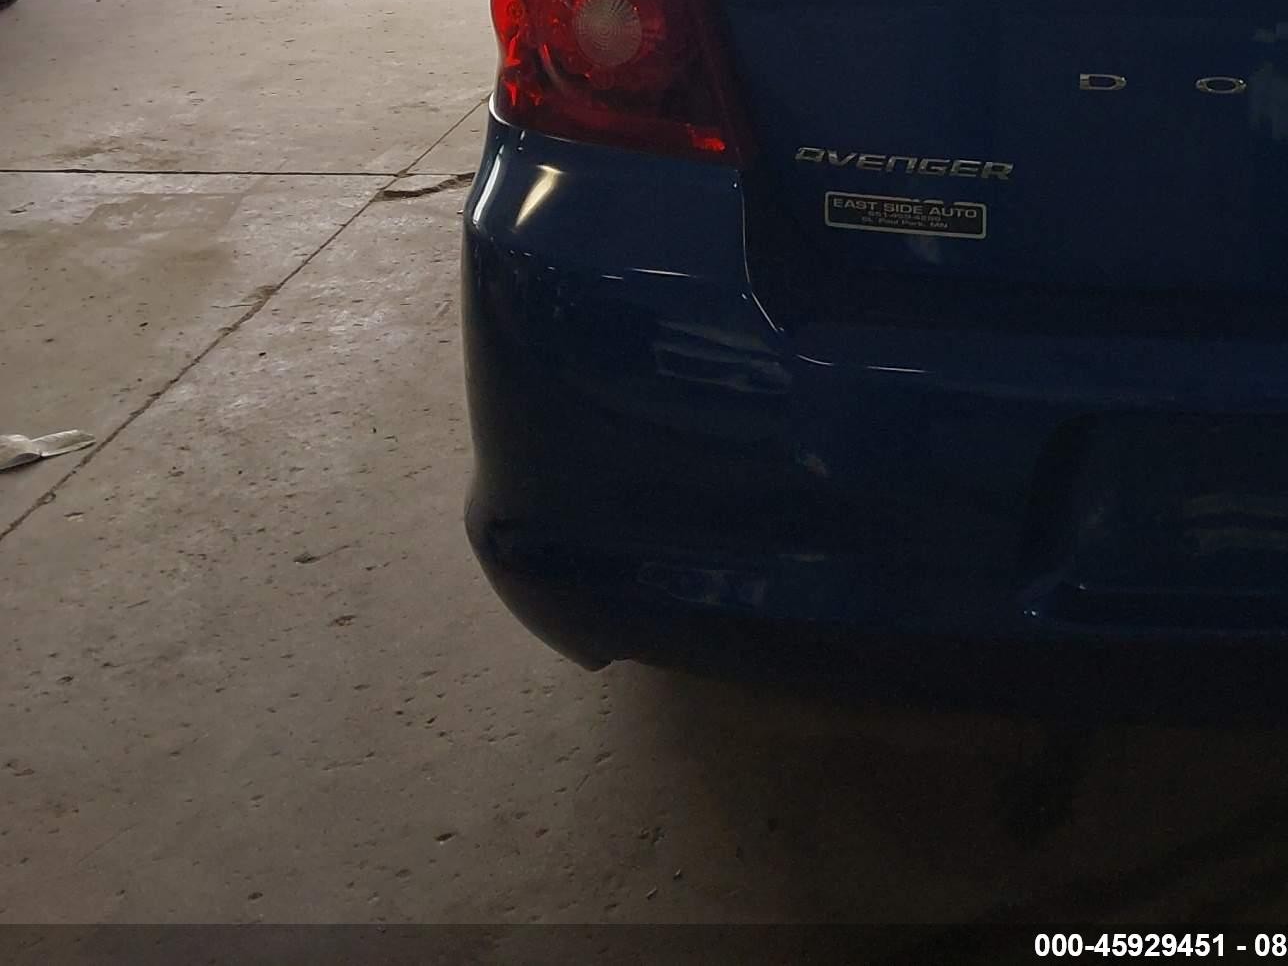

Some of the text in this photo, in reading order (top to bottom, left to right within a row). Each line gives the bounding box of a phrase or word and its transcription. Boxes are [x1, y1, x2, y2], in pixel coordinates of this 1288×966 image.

[794, 146, 1014, 180] AVENGER
[833, 198, 977, 219] EAST SIDE AUTO
